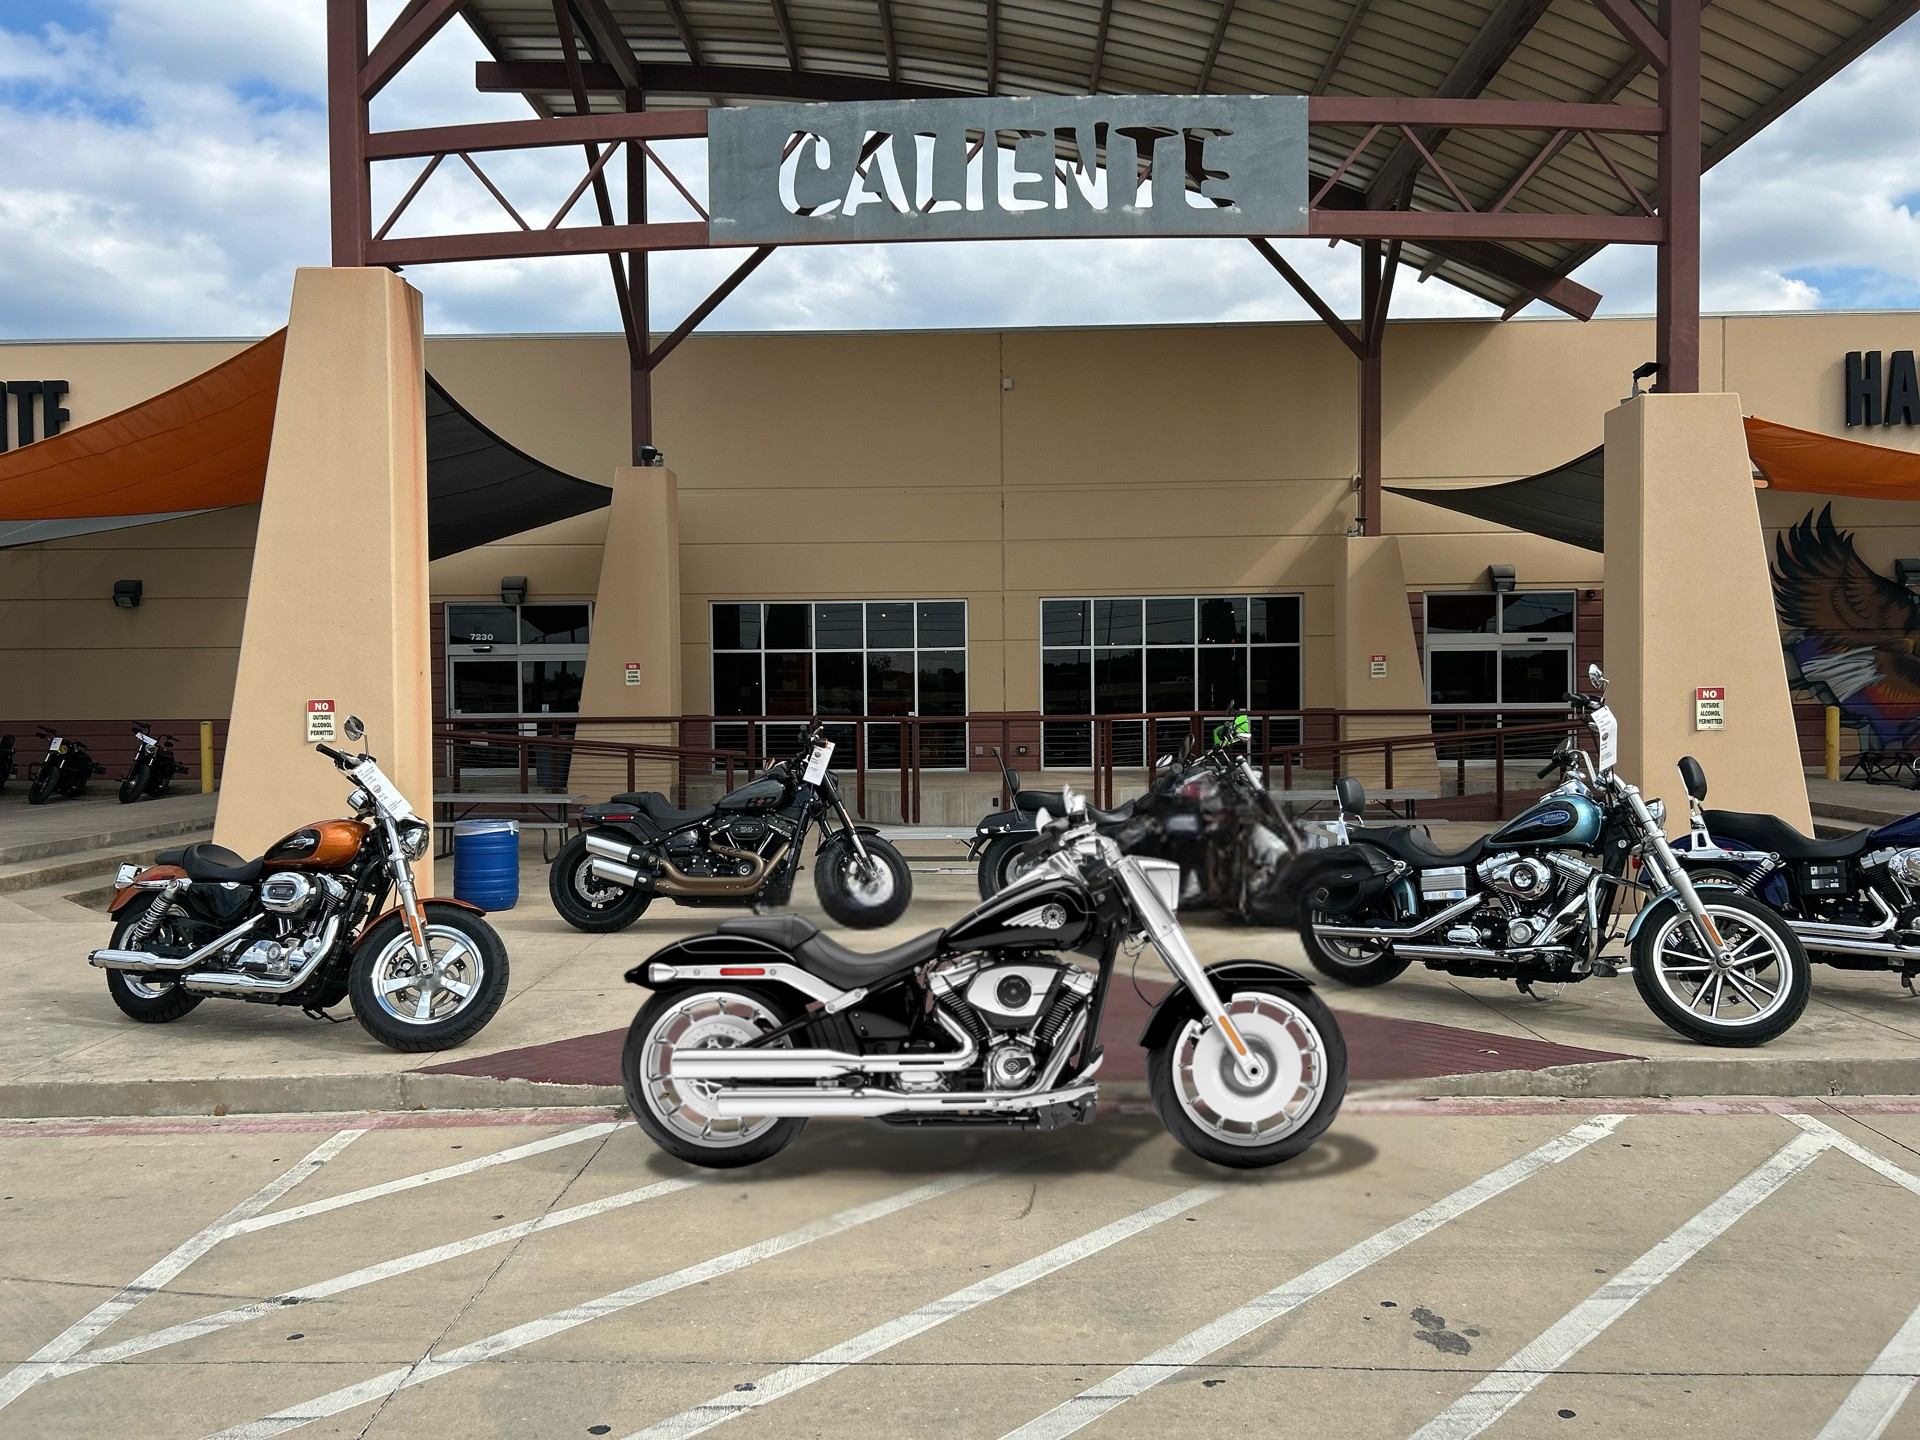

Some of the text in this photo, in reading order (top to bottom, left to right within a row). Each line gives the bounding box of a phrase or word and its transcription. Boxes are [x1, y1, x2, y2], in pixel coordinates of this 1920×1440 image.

[778, 121, 1236, 217] CALIENTE
[470, 633, 494, 642] 7230
[1702, 690, 1718, 699] NO
[314, 702, 329, 711] NO
